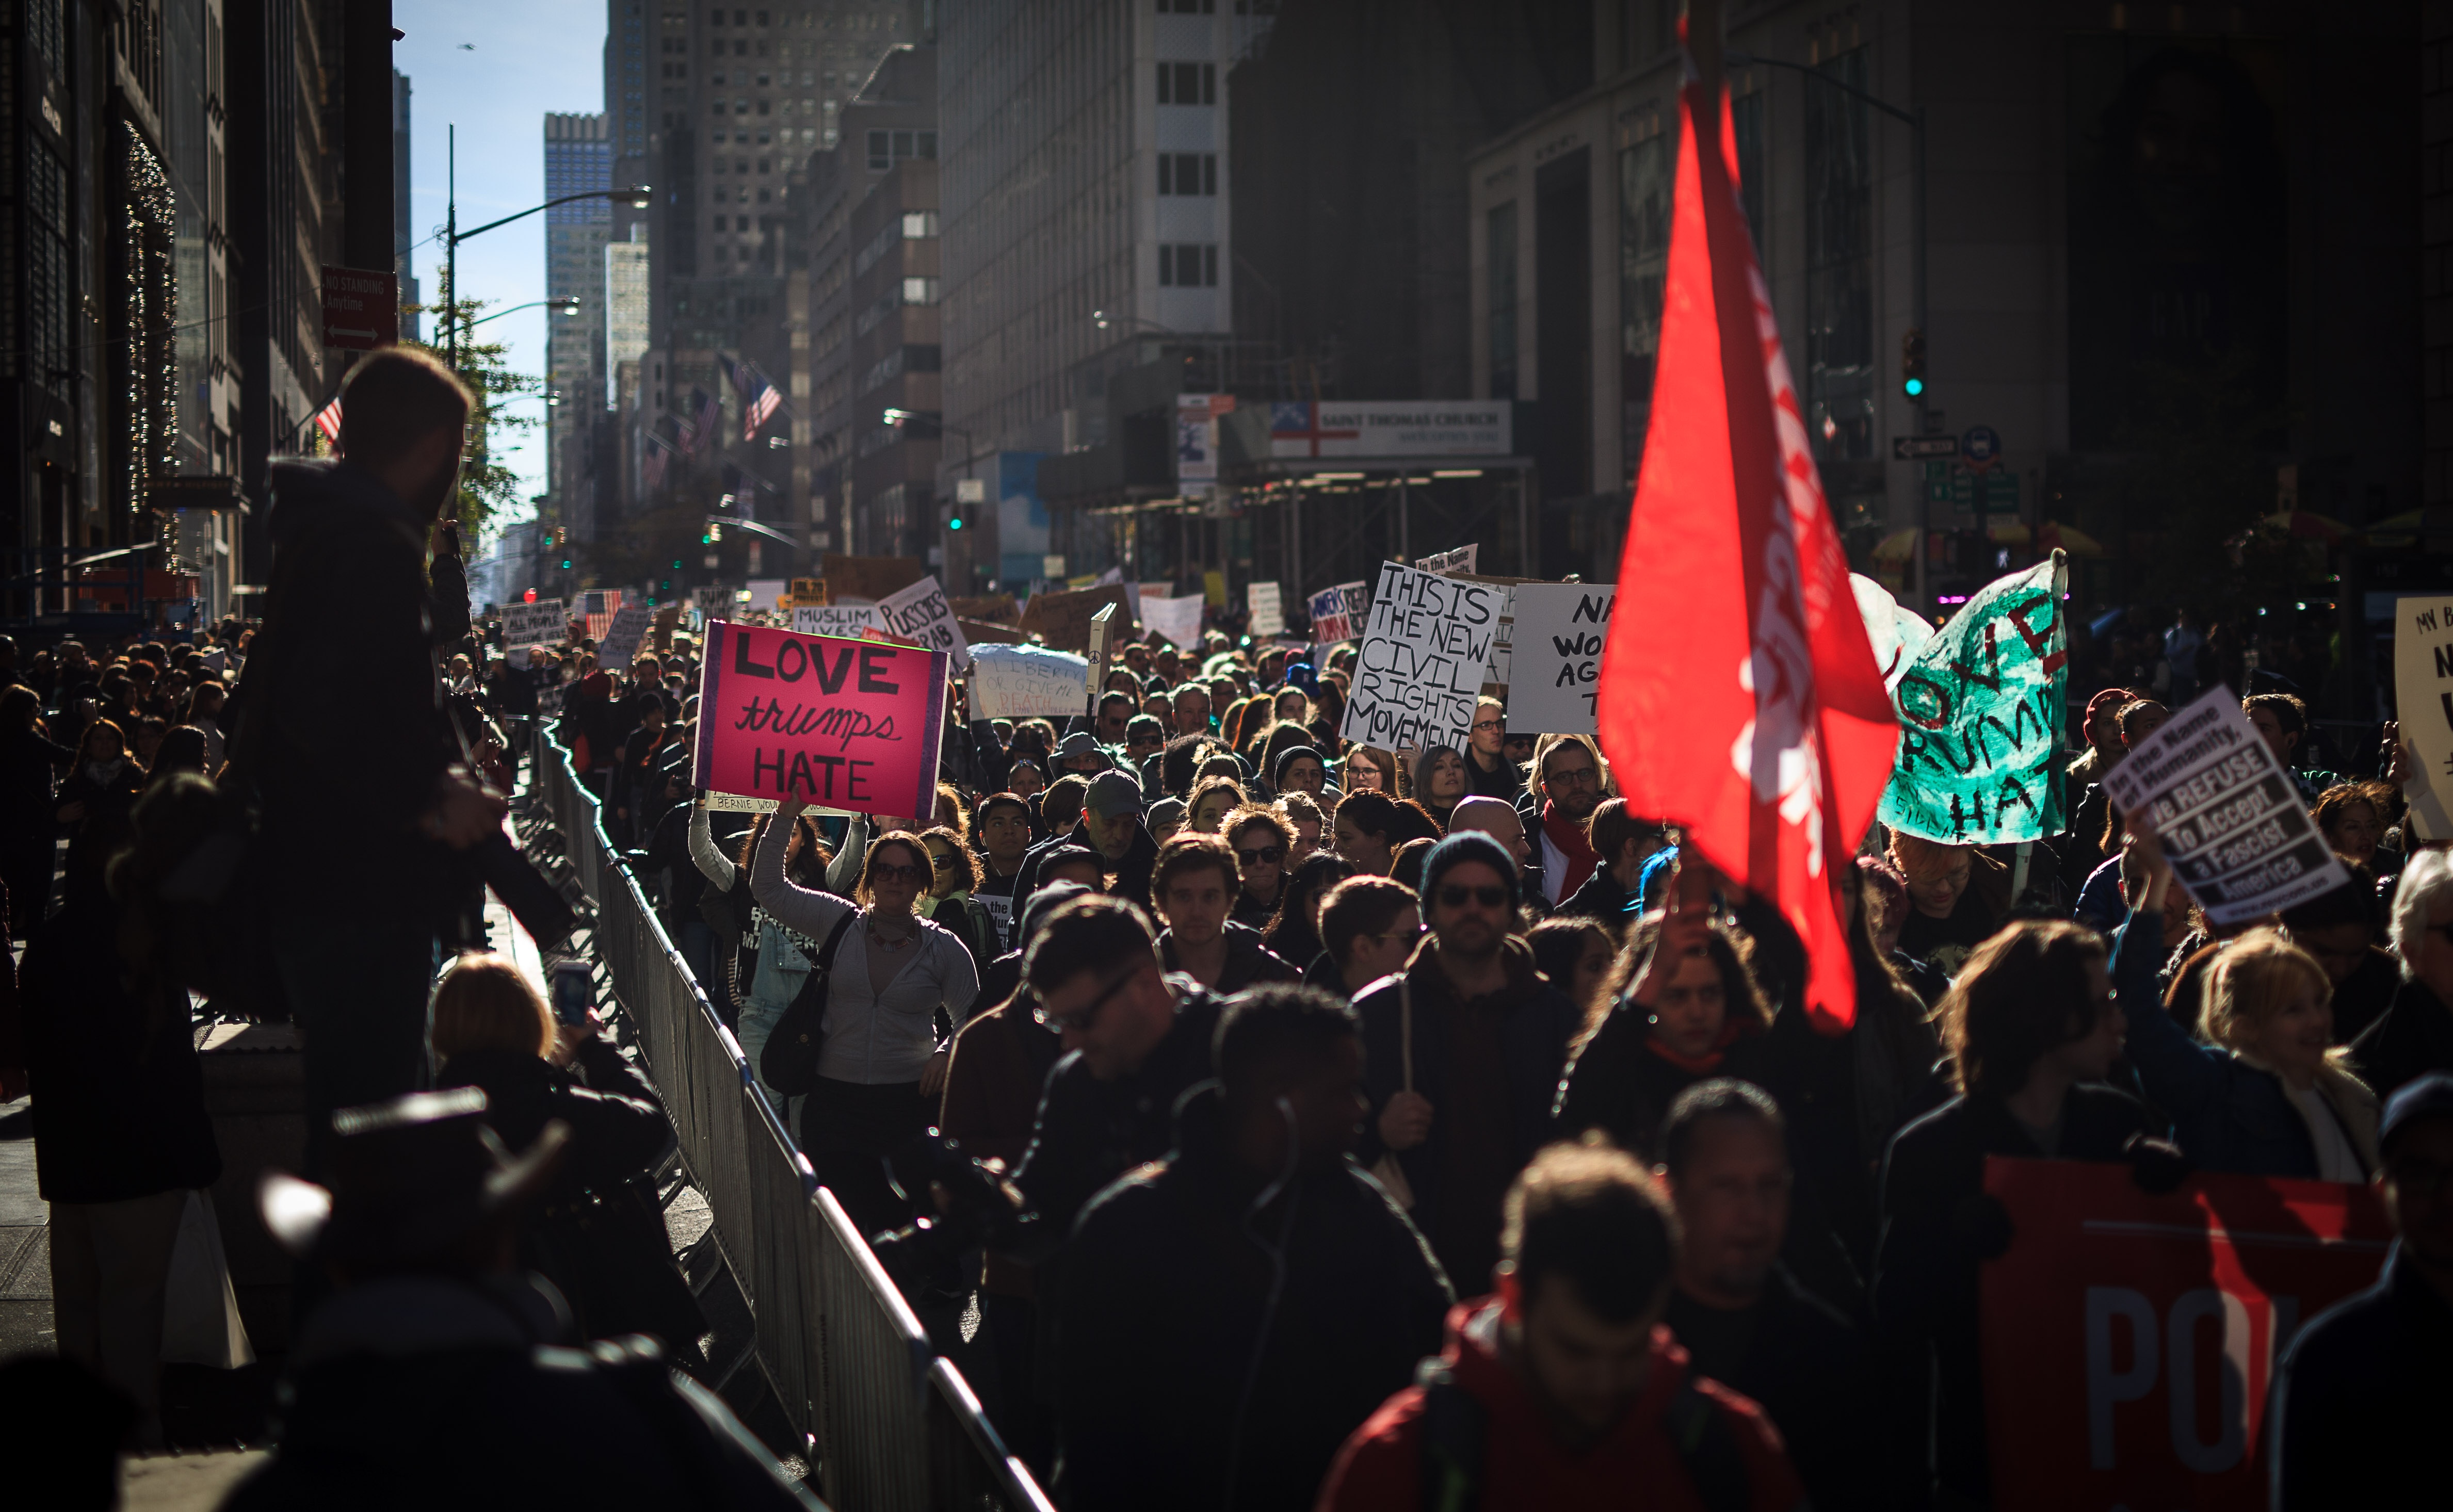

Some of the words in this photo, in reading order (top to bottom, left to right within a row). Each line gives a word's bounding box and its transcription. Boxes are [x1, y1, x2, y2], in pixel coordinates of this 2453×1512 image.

[326, 275, 338, 290] NO
[341, 277, 384, 295] STANDING
[327, 294, 363, 312] Anytime
[1322, 414, 1363, 427] SAINT
[1368, 414, 1431, 426] THOMAS
[1434, 413, 1498, 426] CHURCH
[1430, 557, 1445, 571] the
[1447, 549, 1470, 567] Name
[700, 591, 732, 604] DUMP
[879, 590, 948, 637] PUSSIES
[1383, 565, 1445, 617] THIS
[1444, 583, 1490, 625] IS
[1572, 593, 1617, 624] NA
[509, 619, 526, 629] ALL
[528, 614, 560, 629] PEOPLE
[799, 608, 873, 625] MUSLIM
[1376, 600, 1425, 638] THE
[1429, 618, 1491, 663] NEW
[2416, 608, 2438, 635] MY
[912, 624, 954, 651] RAB
[1552, 631, 1611, 658] WO
[734, 632, 900, 696] LOVE
[994, 658, 1080, 680] LIBERTY
[1362, 637, 1475, 695] CIVIL
[1889, 590, 2067, 733] OVE
[987, 677, 1006, 691] OR
[1015, 678, 1051, 695] GIVE
[998, 692, 1052, 716] DEATH
[1359, 672, 1473, 728] RIGHTS
[734, 696, 903, 753] trumps
[1345, 697, 1470, 753] MOVEMENT
[2110, 773, 2130, 795] In
[2130, 746, 2163, 772] the
[2160, 706, 2221, 748] Name
[2122, 787, 2142, 809] of
[2142, 722, 2243, 789] Humanity,
[753, 747, 875, 802] HATE
[2171, 745, 2266, 811] REFUSE
[717, 798, 752, 809] BERNIE
[2165, 827, 2198, 853] To
[2194, 783, 2274, 840] Accept
[2192, 860, 2210, 878] a
[2206, 817, 2289, 871] Fascist
[2218, 853, 2303, 902] America
[990, 901, 1008, 914] the
